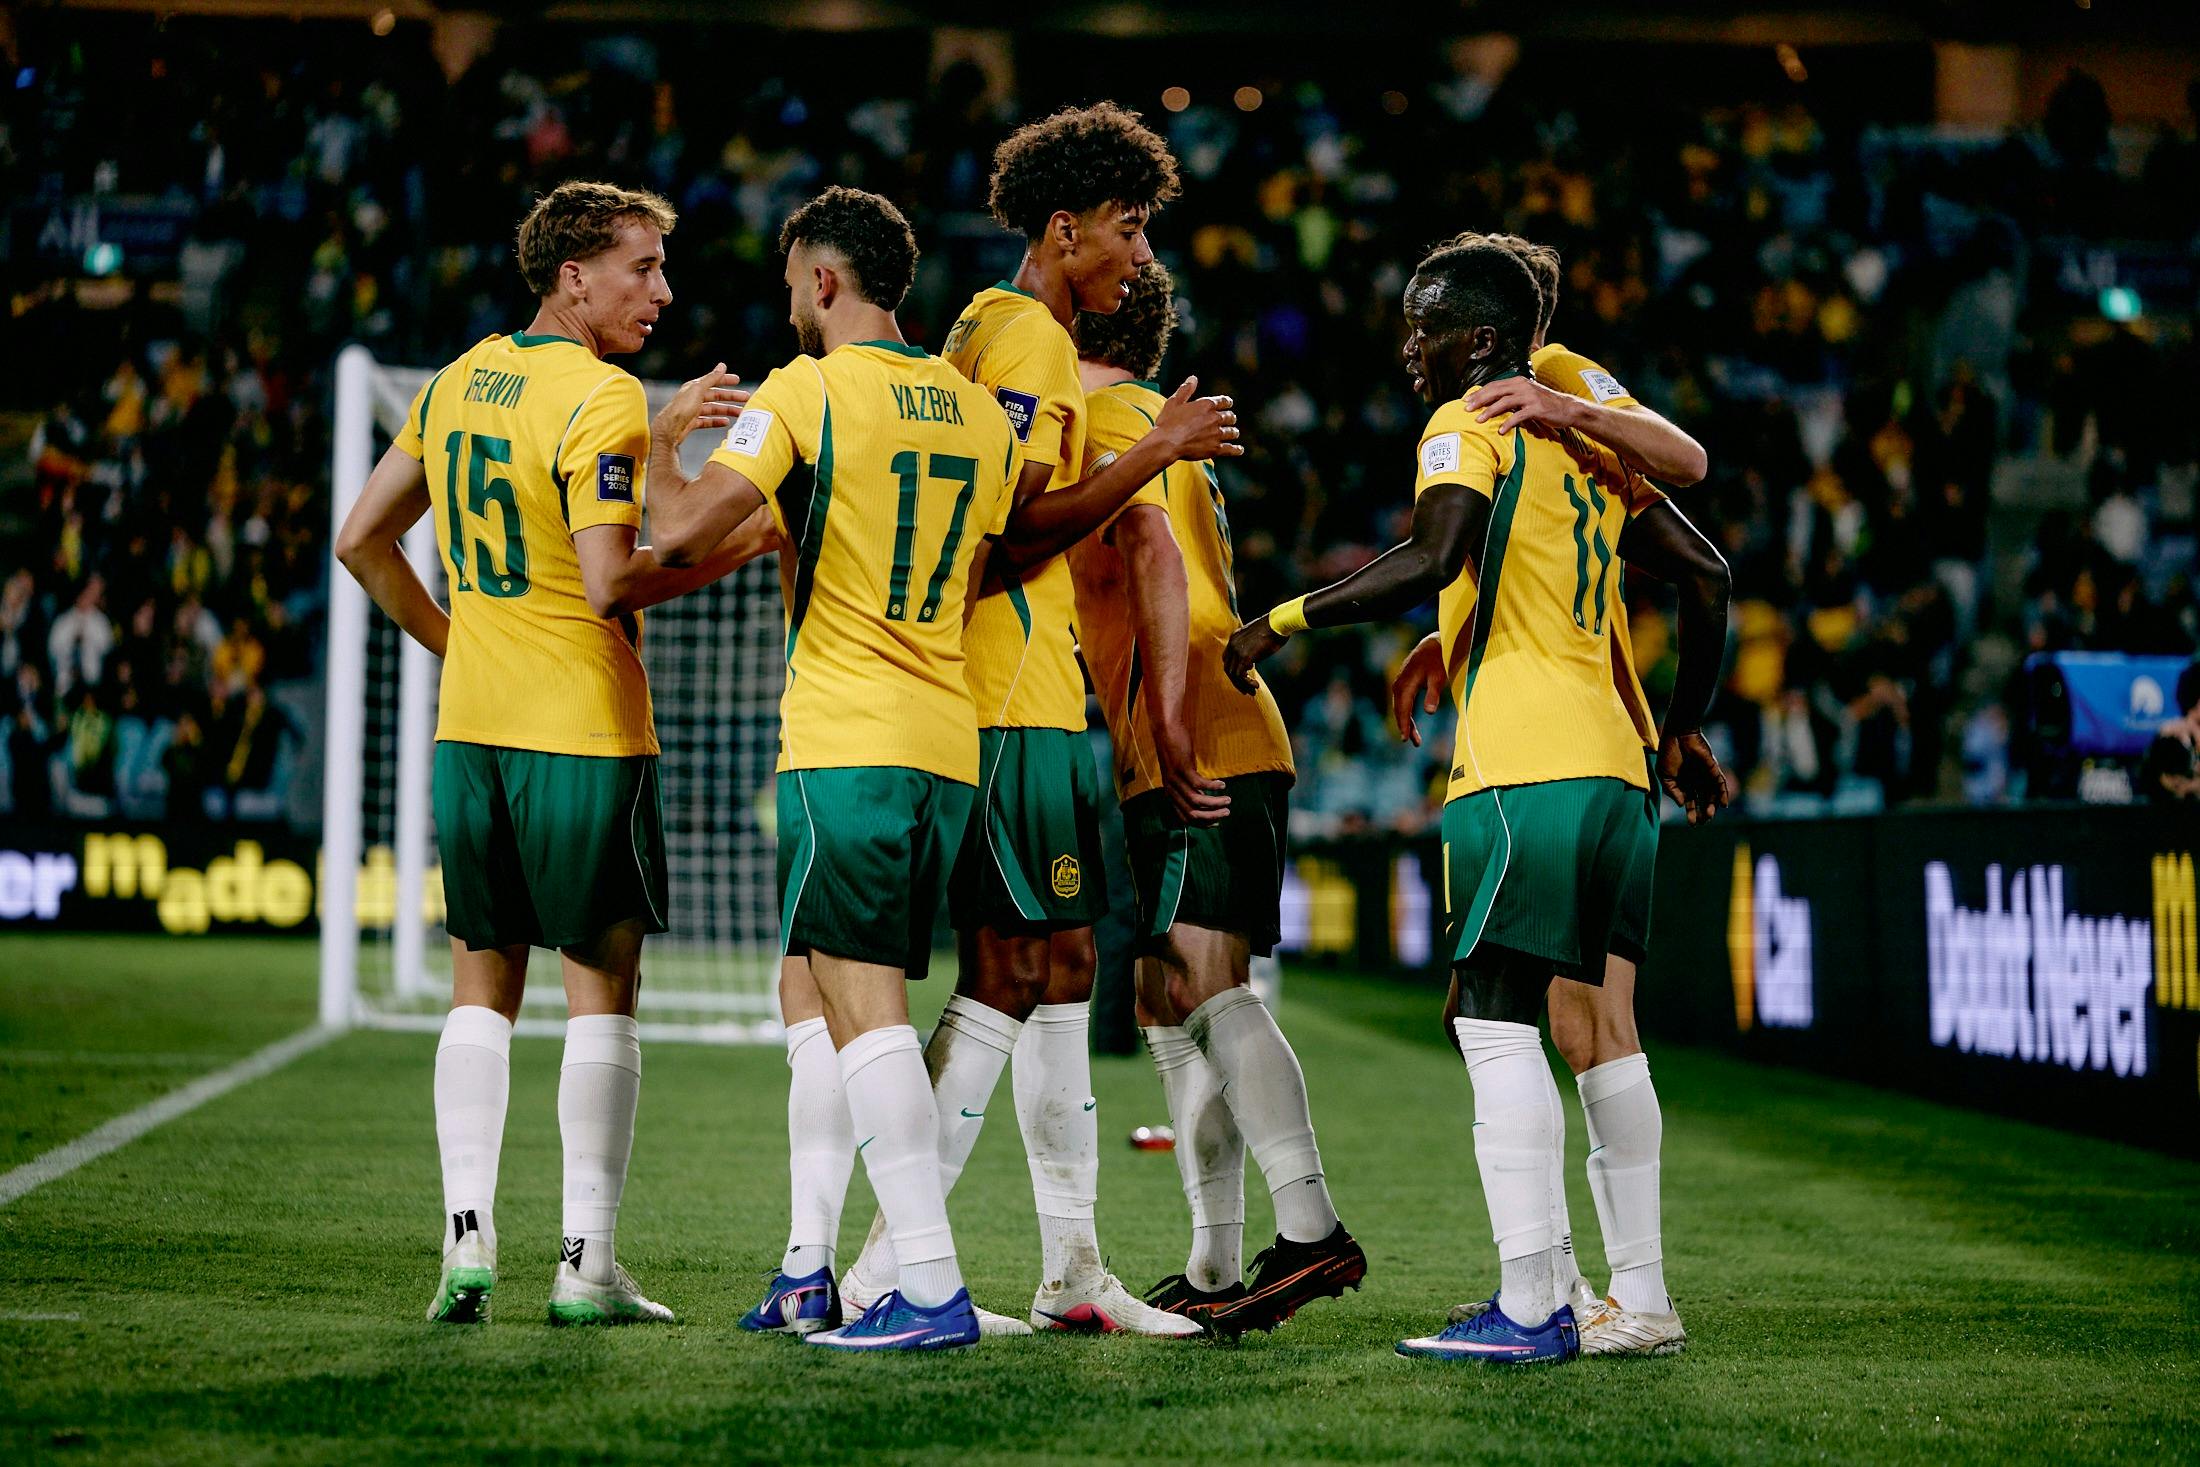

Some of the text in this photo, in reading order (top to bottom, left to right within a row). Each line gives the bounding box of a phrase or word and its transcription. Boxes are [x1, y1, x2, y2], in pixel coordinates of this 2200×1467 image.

[889, 383, 964, 426] YAZBEK
[1005, 401, 1025, 413] FIFA
[603, 473, 630, 484] SERIES
[608, 465, 626, 474] FIFA
[608, 481, 628, 491] 2026
[445, 431, 531, 597] 15
[885, 451, 979, 622] 17
[1564, 473, 1611, 636] 11
[83, 832, 313, 936] made
[1924, 860, 2034, 1063] Doubt
[2030, 863, 2152, 1078] Never
